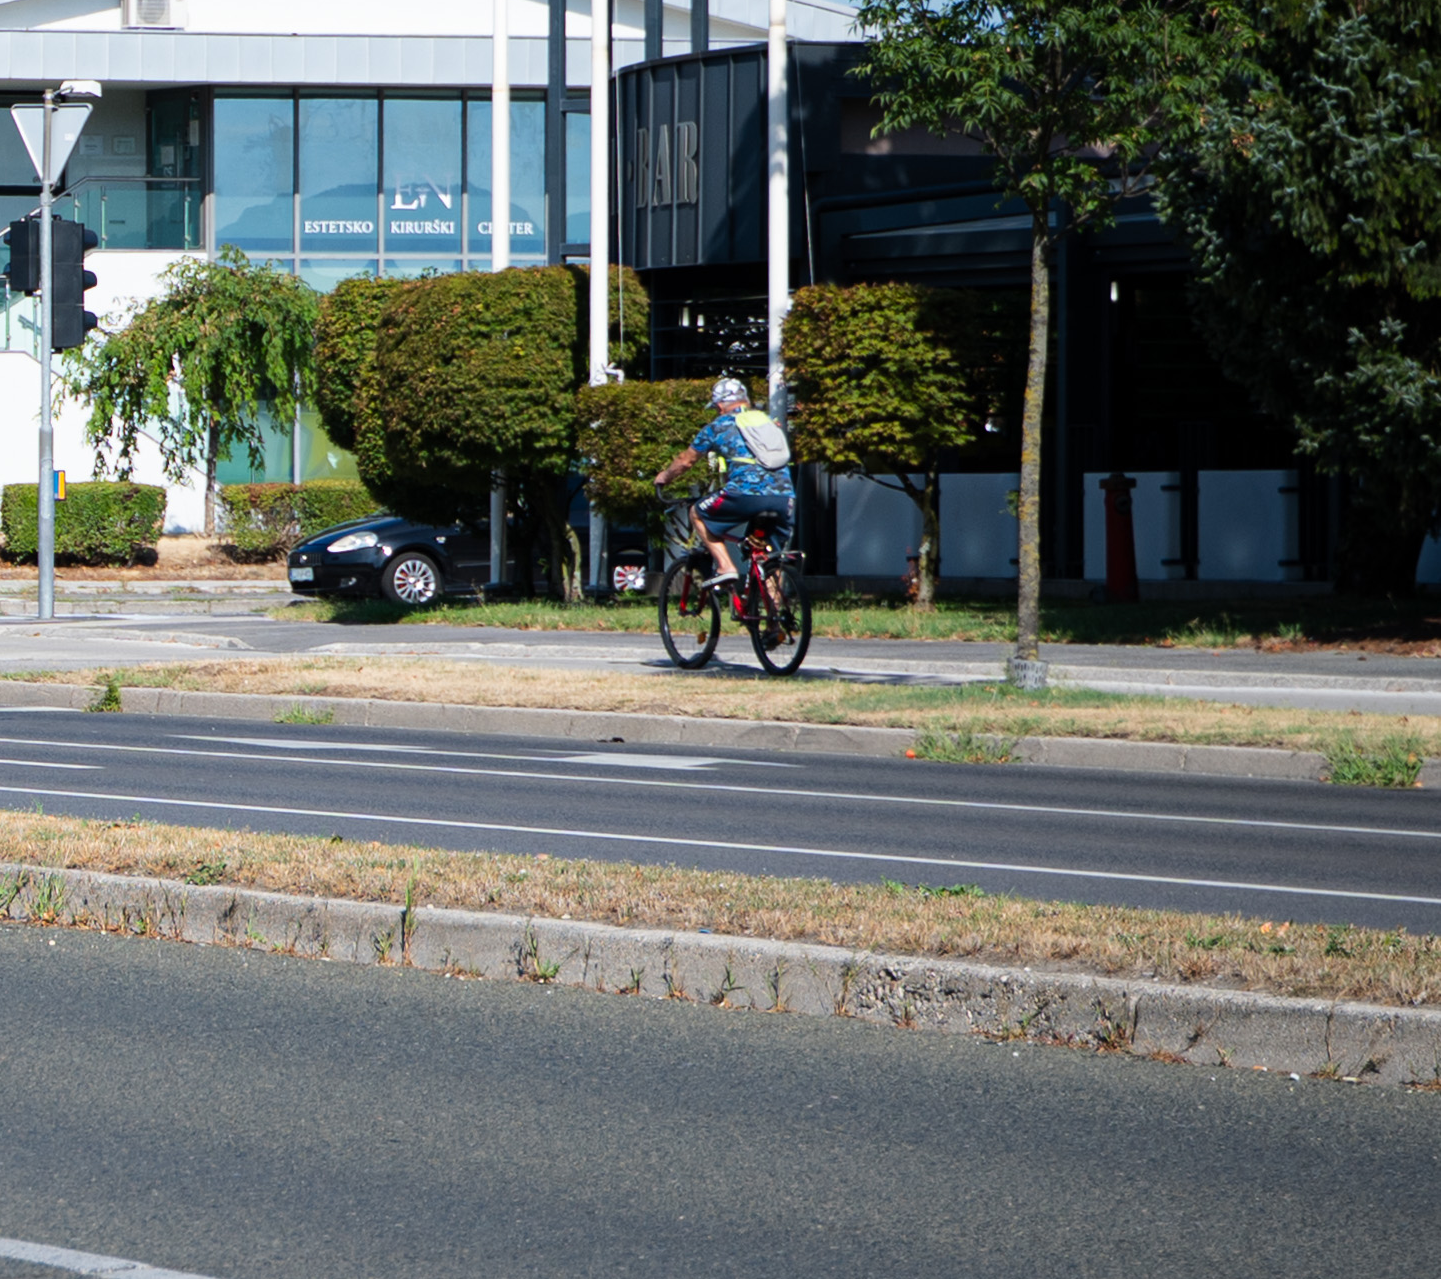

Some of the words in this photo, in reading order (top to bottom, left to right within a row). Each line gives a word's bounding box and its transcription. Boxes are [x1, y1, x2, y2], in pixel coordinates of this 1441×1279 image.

[636, 121, 698, 208] BAR
[304, 220, 374, 234] ESTETSKO
[390, 218, 455, 234] KIRURŠKI
